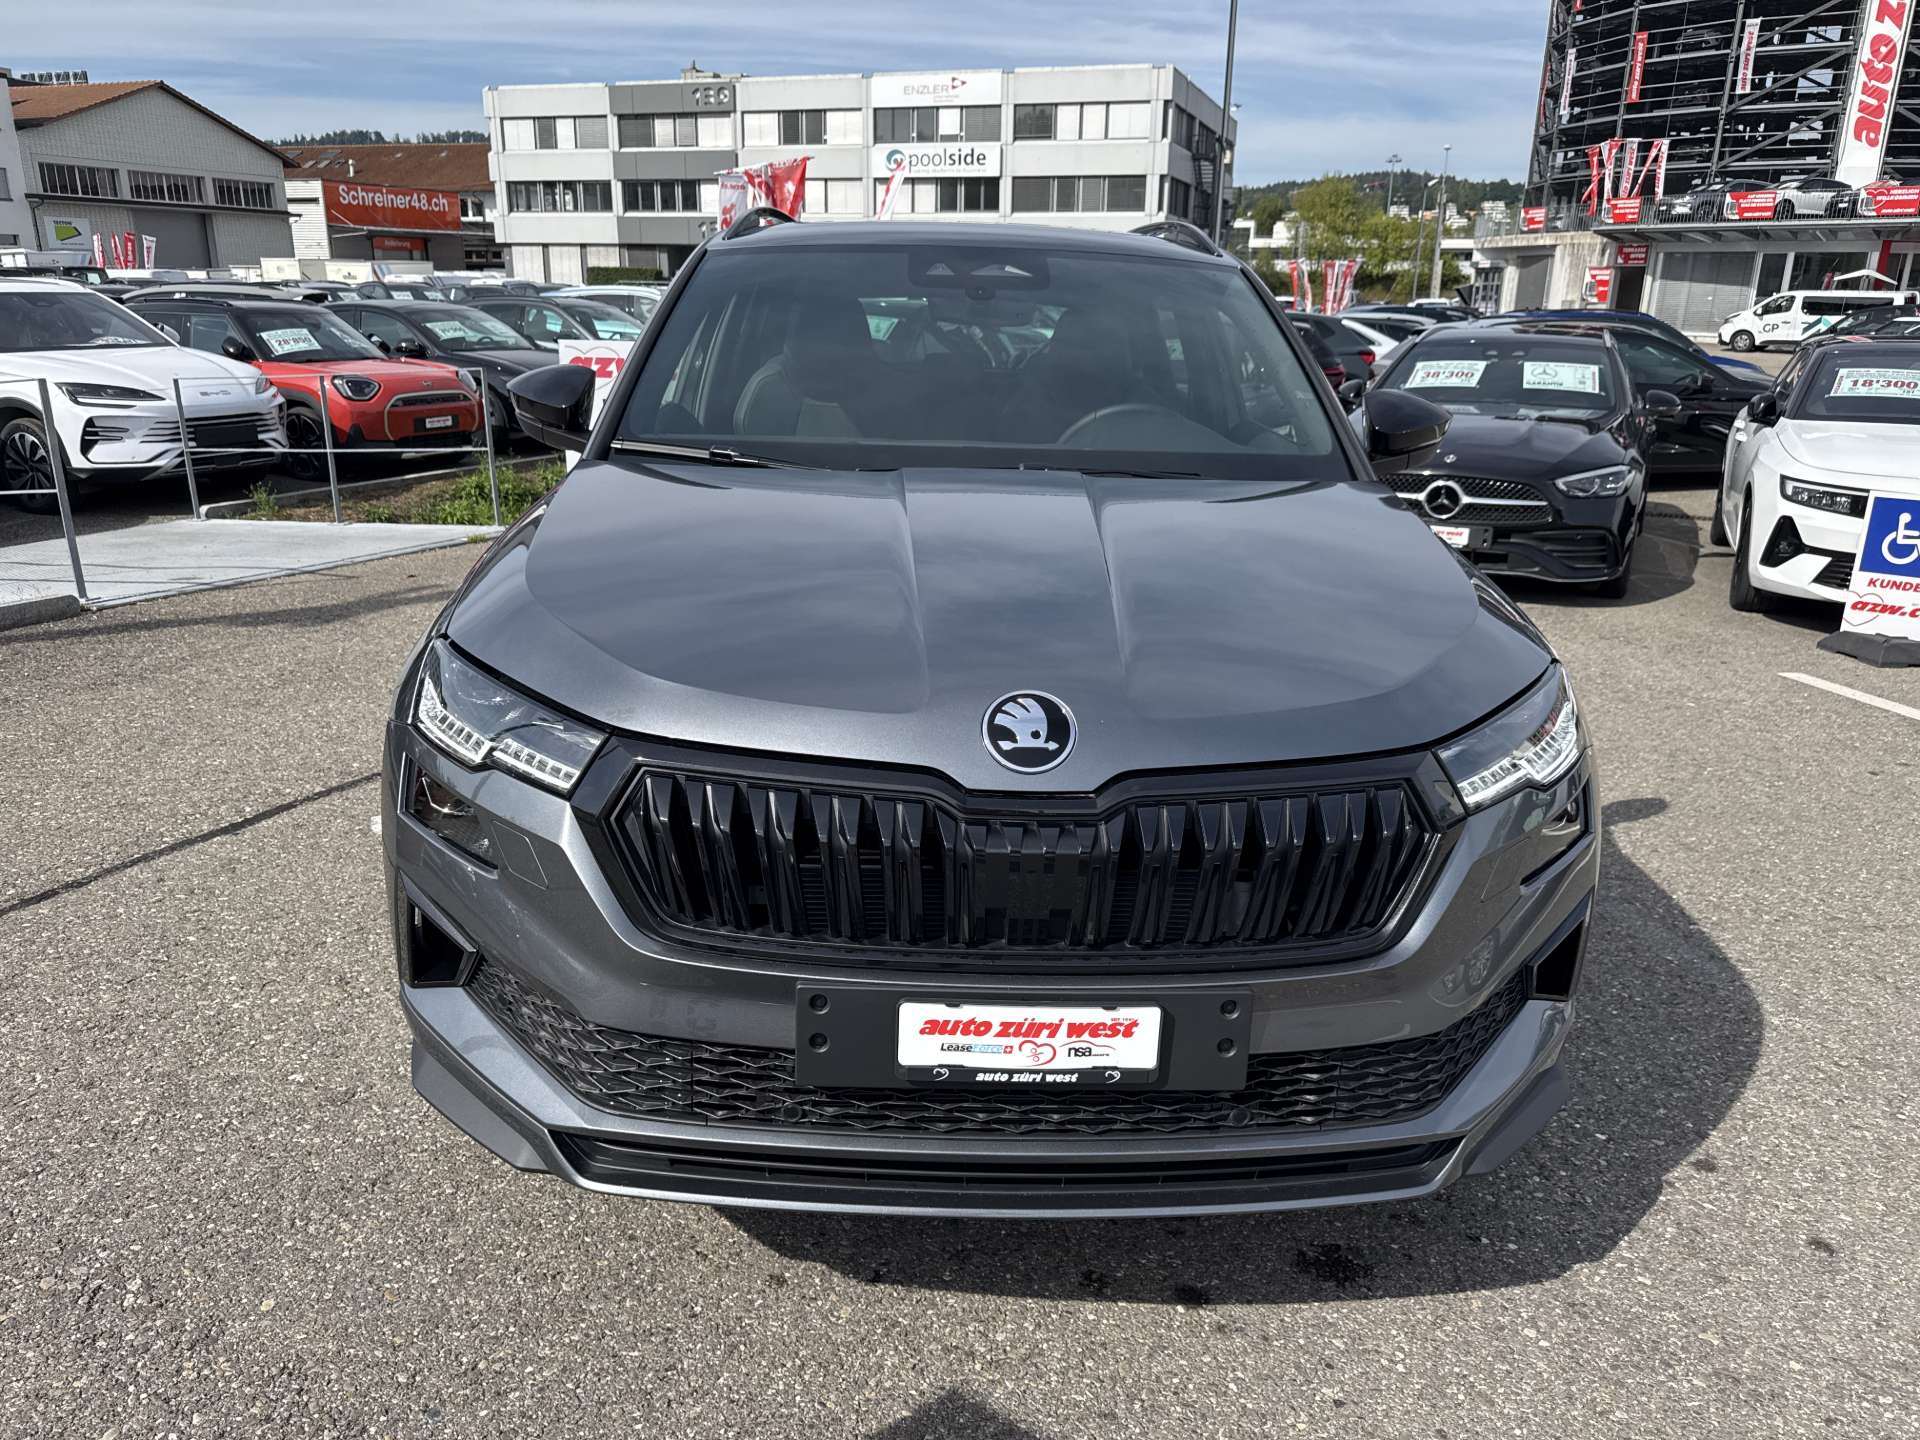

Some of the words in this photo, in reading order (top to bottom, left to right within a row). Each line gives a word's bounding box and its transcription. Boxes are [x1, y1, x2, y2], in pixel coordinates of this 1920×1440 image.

[904, 84, 949, 95] ENZLER
[1854, 34, 1897, 148] auto
[909, 147, 986, 173] poolside
[339, 185, 448, 212] Schreiner48.ch
[1763, 323, 1779, 333] GP
[1423, 370, 1474, 378] 38'300
[1851, 379, 1919, 389] 18'300
[919, 1017, 993, 1037] auto
[993, 1018, 1064, 1038] züri
[1067, 1019, 1140, 1038] west
[1068, 1047, 1092, 1057] nsa
[975, 1072, 1010, 1081] auto
[1010, 1072, 1043, 1082] züri
[1045, 1073, 1079, 1082] west
